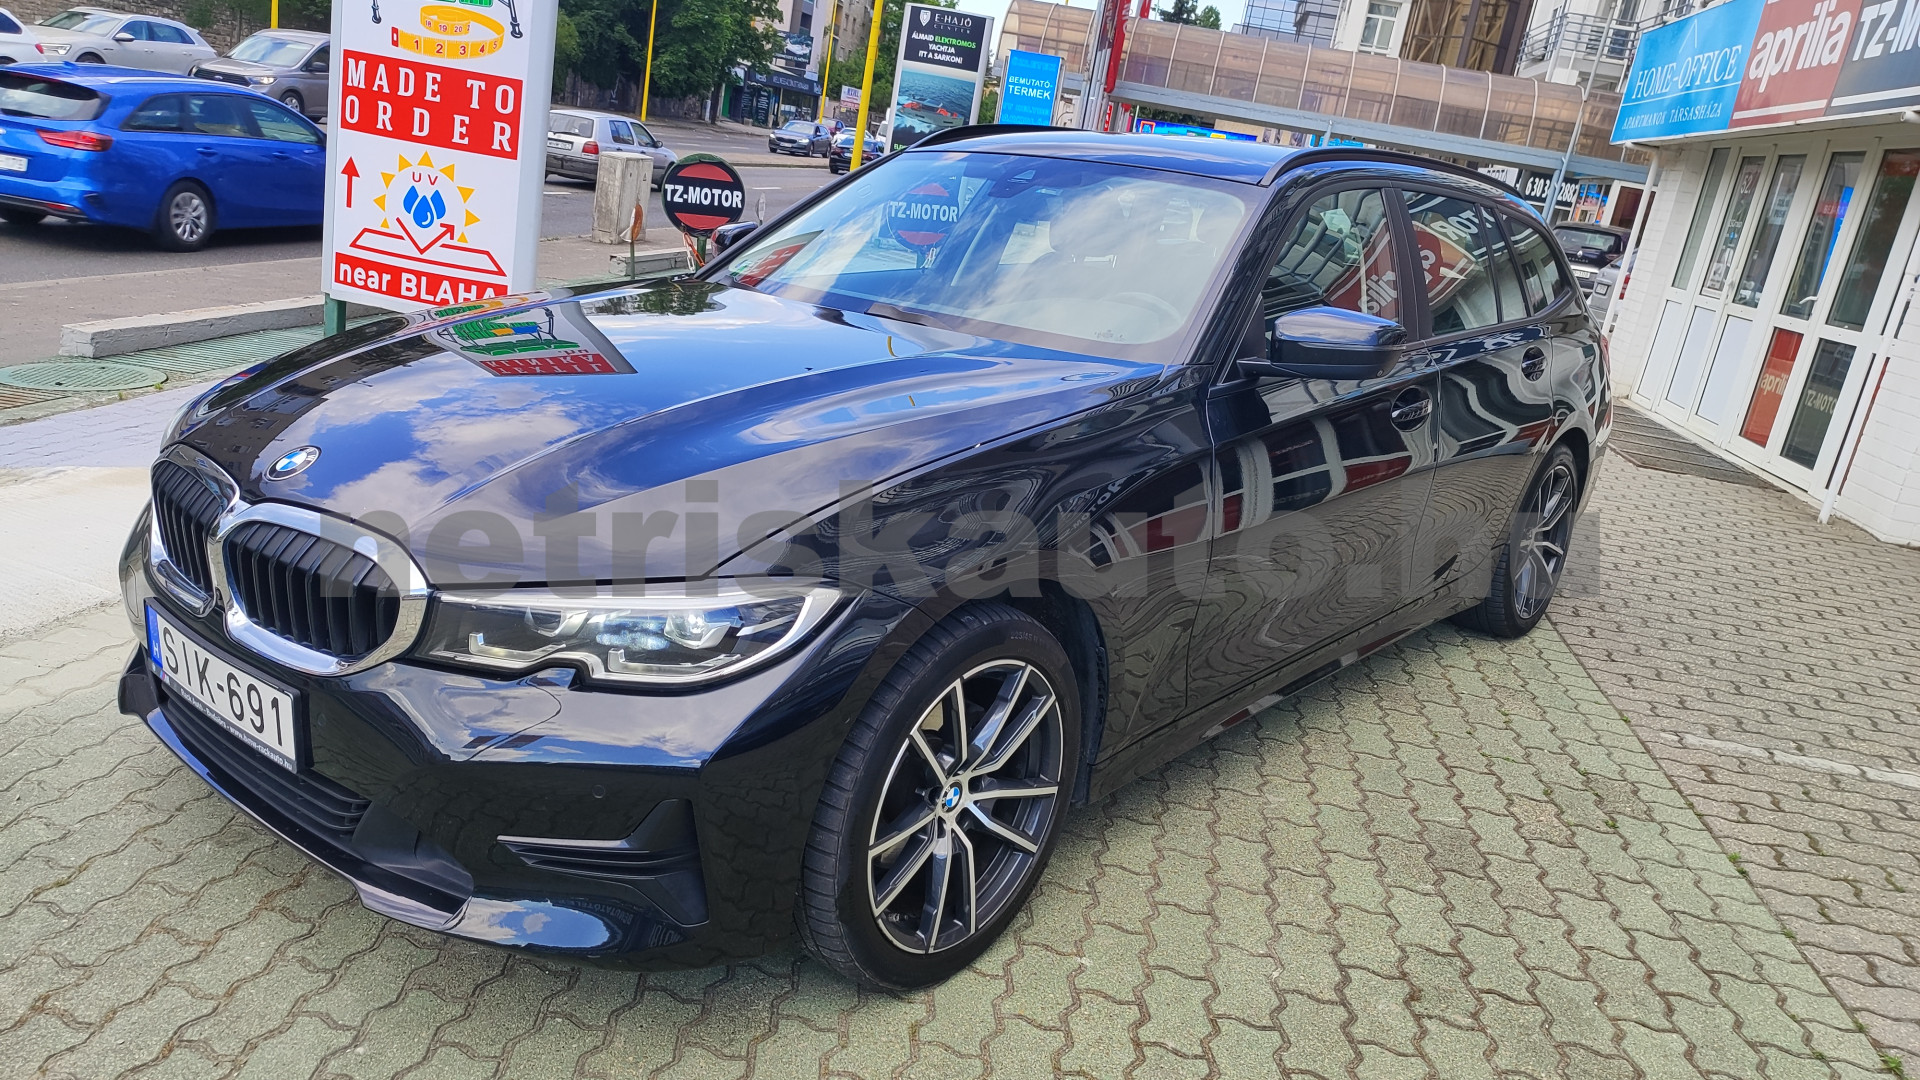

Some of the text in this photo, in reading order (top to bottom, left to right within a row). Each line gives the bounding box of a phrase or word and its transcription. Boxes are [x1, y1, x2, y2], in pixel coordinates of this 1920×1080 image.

[935, 35, 976, 49] ELEKTROMOS
[1852, 0, 1920, 61] TZ-M
[414, 40, 419, 50] 1
[436, 43, 443, 54] 2
[459, 45, 466, 55] 3
[479, 44, 485, 53] 4
[1749, 0, 1852, 93] aprilia
[1631, 44, 1743, 99] HOME-OFFICE
[346, 58, 515, 114] MADE TO
[1008, 85, 1051, 100] TERMEK
[345, 95, 512, 152] ORDER
[1669, 101, 1723, 124] TÁRSASHÁZA
[664, 184, 743, 209] TZ-MOTOR
[890, 201, 958, 222] TZ-MOTOR
[339, 262, 391, 292] near
[152, 641, 160, 659] H
[163, 626, 283, 747] SIK-691
